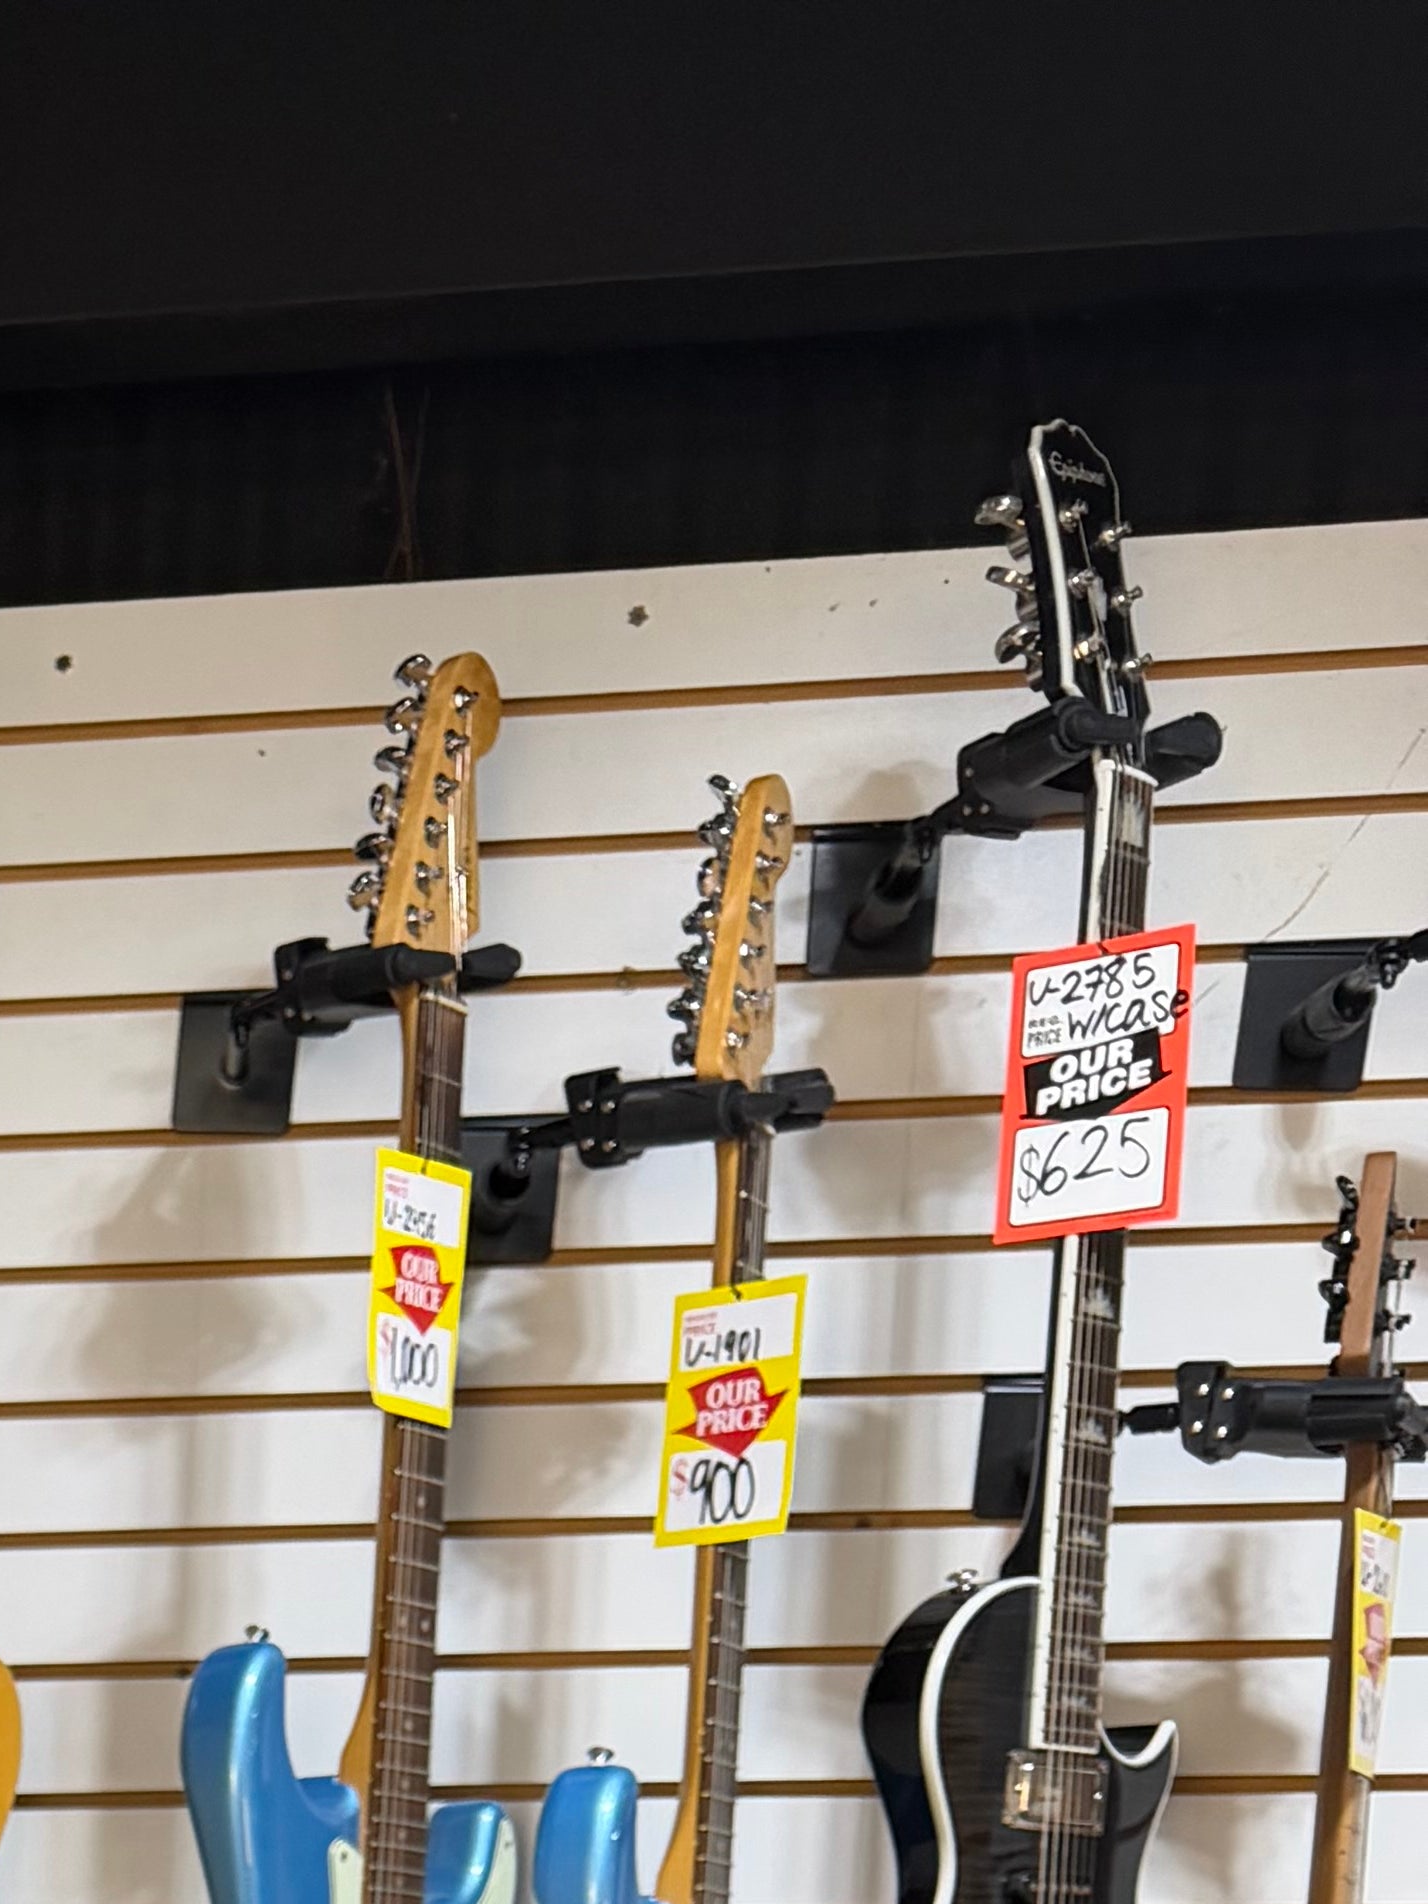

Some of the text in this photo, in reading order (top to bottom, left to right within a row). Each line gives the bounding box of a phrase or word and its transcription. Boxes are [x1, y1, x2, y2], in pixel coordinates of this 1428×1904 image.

[1049, 1037, 1134, 1083] OUR
[1035, 1057, 1154, 1117] PRICE
[1017, 1116, 1151, 1208] $625
[399, 1250, 439, 1284] OUR
[394, 1279, 443, 1314] PRICE
[705, 1376, 761, 1410] OUR
[695, 1403, 769, 1438] PRICE
[669, 1456, 756, 1525] $900
